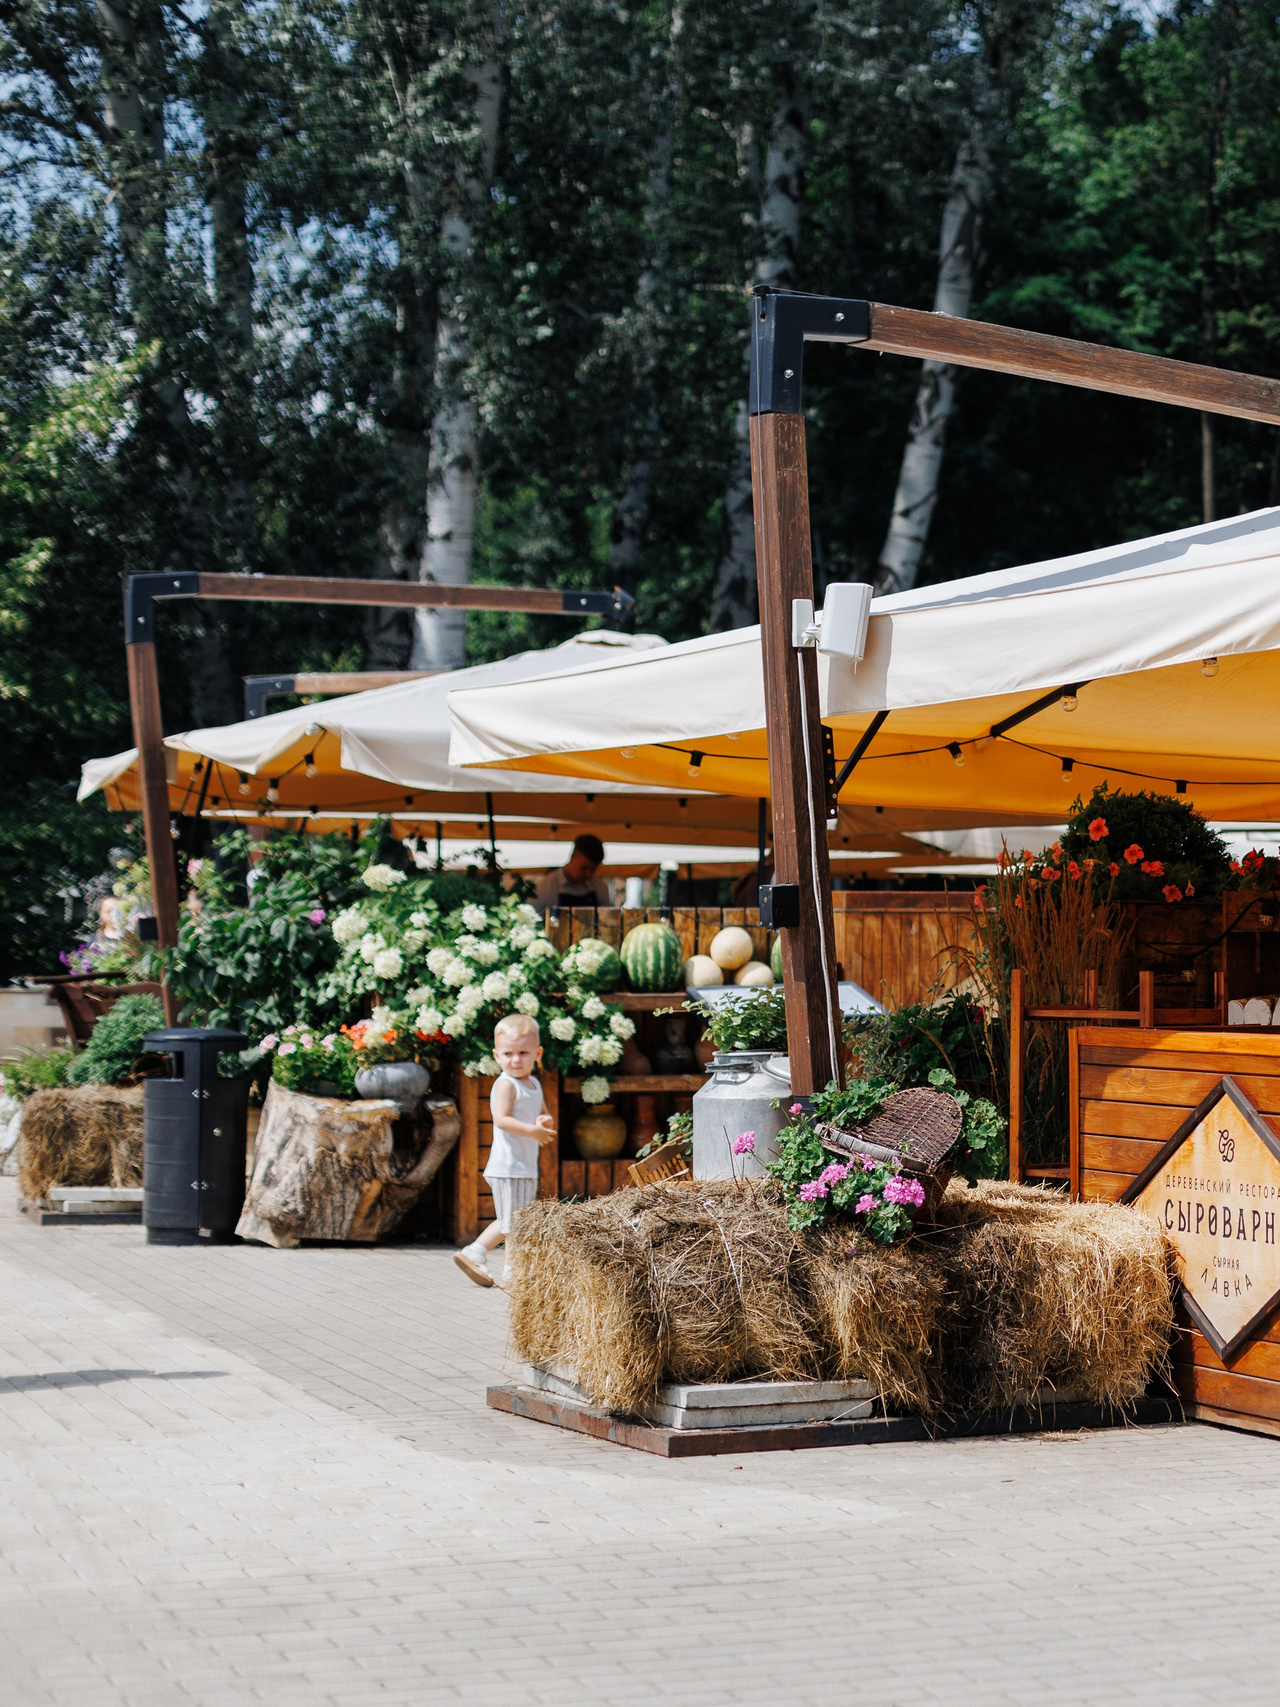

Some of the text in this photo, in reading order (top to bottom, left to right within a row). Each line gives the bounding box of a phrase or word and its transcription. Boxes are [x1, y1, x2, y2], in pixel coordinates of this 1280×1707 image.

[1166, 1174, 1232, 1194] ДЕРЕВЕНСКИЙ
[1212, 1256, 1240, 1270] СЫРНАЯ
[1200, 1268, 1253, 1298] ЛАВКА
